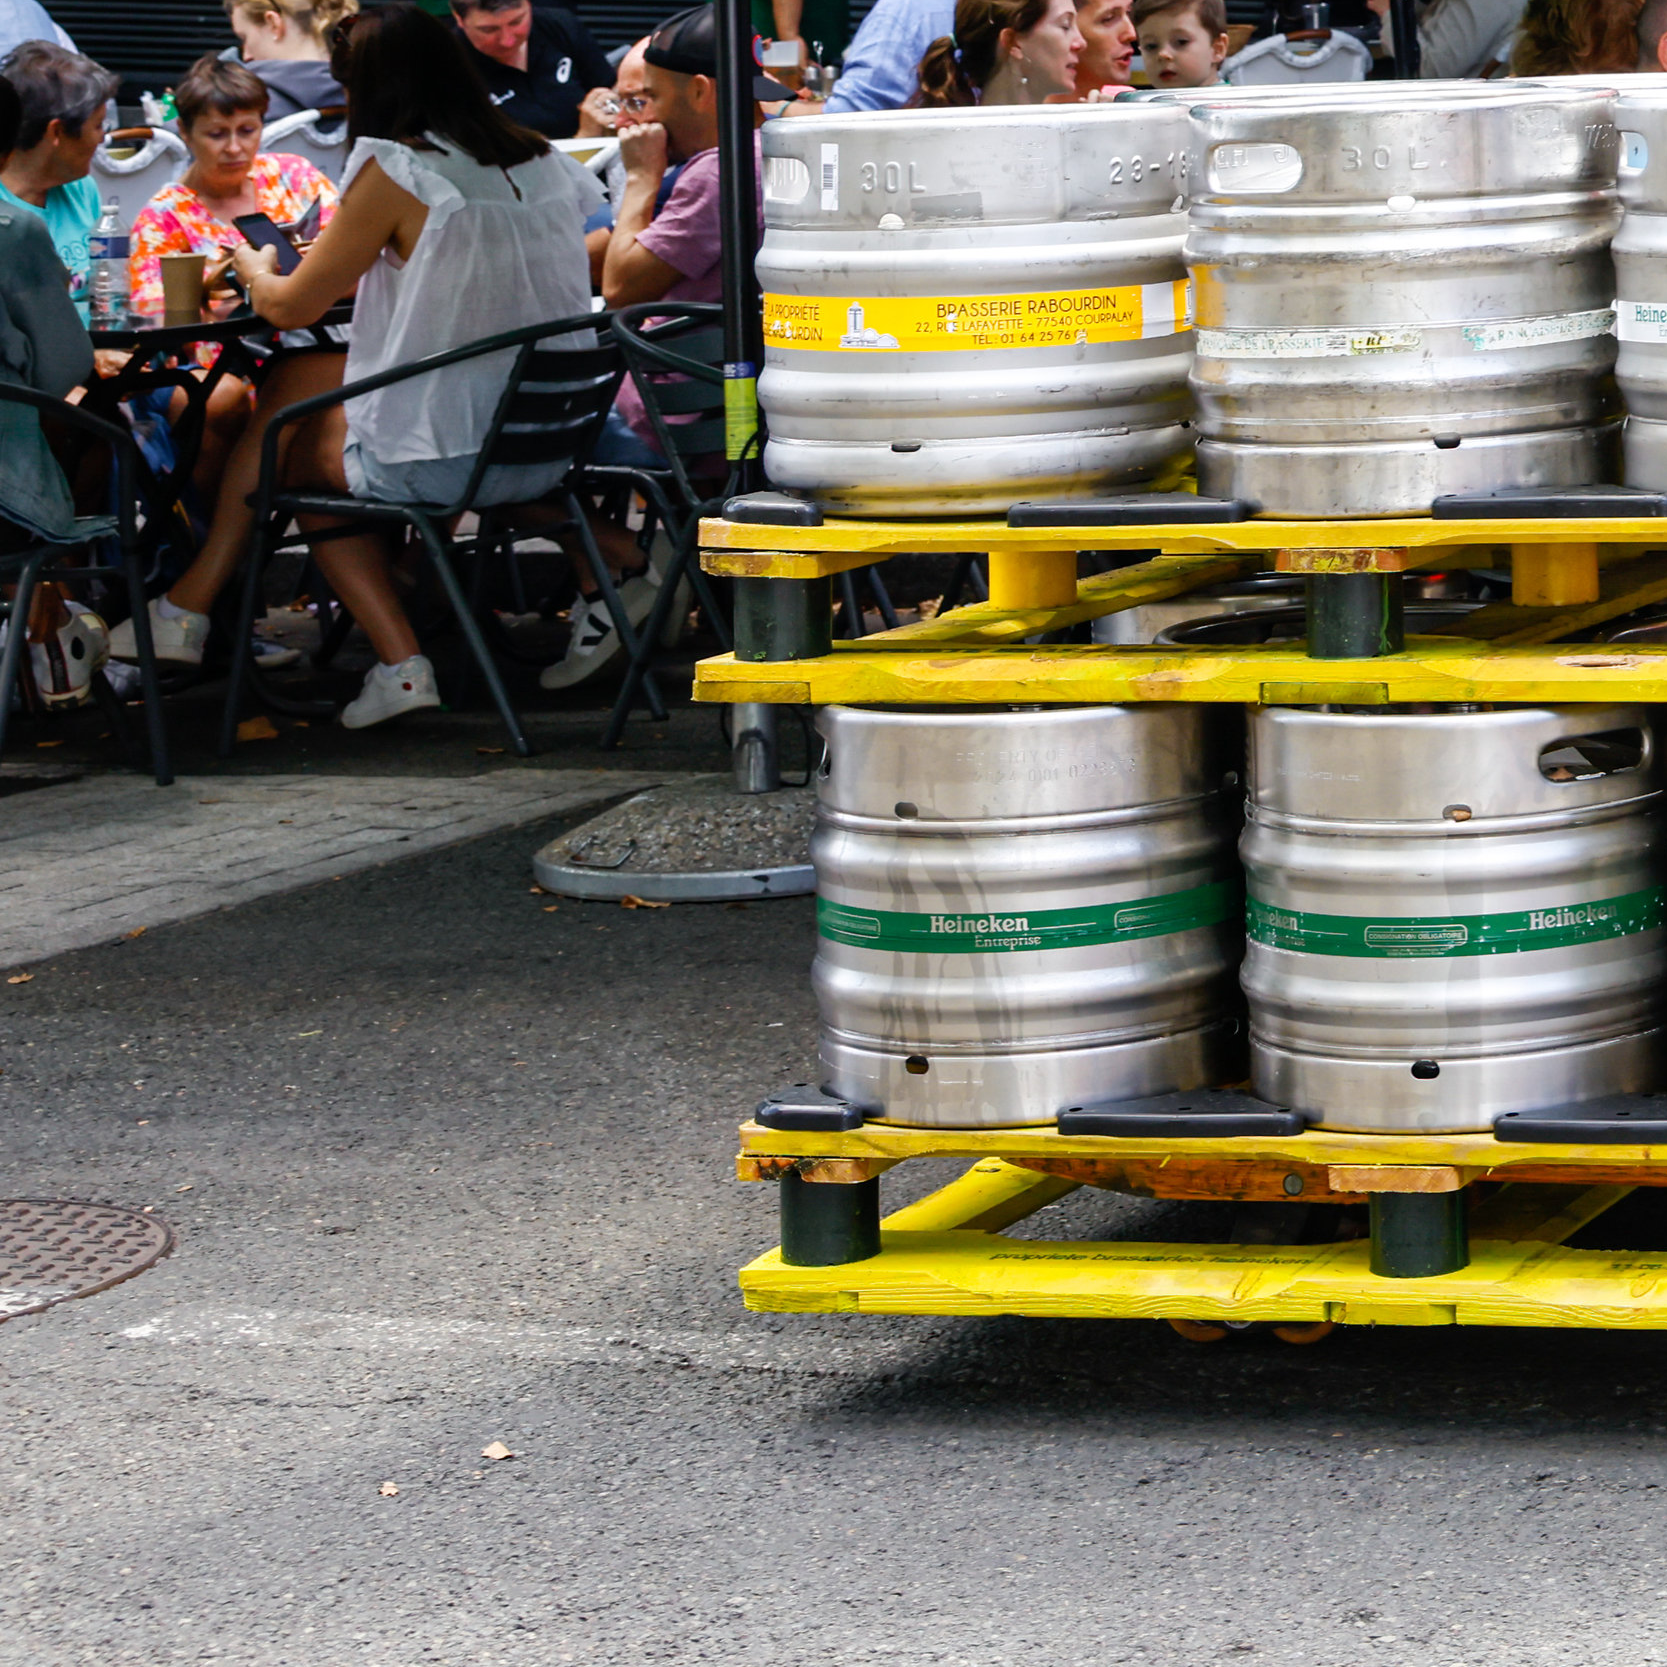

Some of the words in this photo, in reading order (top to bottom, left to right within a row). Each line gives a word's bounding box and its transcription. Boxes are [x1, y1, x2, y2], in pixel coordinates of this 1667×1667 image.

[936, 300, 1022, 319] BRASSERIE
[1027, 294, 1117, 315] RABOURDIN
[915, 322, 933, 333] 22,
[961, 319, 1024, 332] LAFAYETTE
[1036, 316, 1073, 328] 77540
[1075, 310, 1134, 326] COURPALAY
[1000, 333, 1015, 344] 01
[1019, 331, 1035, 343] 64
[1039, 331, 1053, 342] 25
[1057, 329, 1070, 341] 76
[929, 914, 1030, 934] Heineken
[1528, 904, 1618, 932] Heineken
[974, 933, 1043, 951] Entreprise
